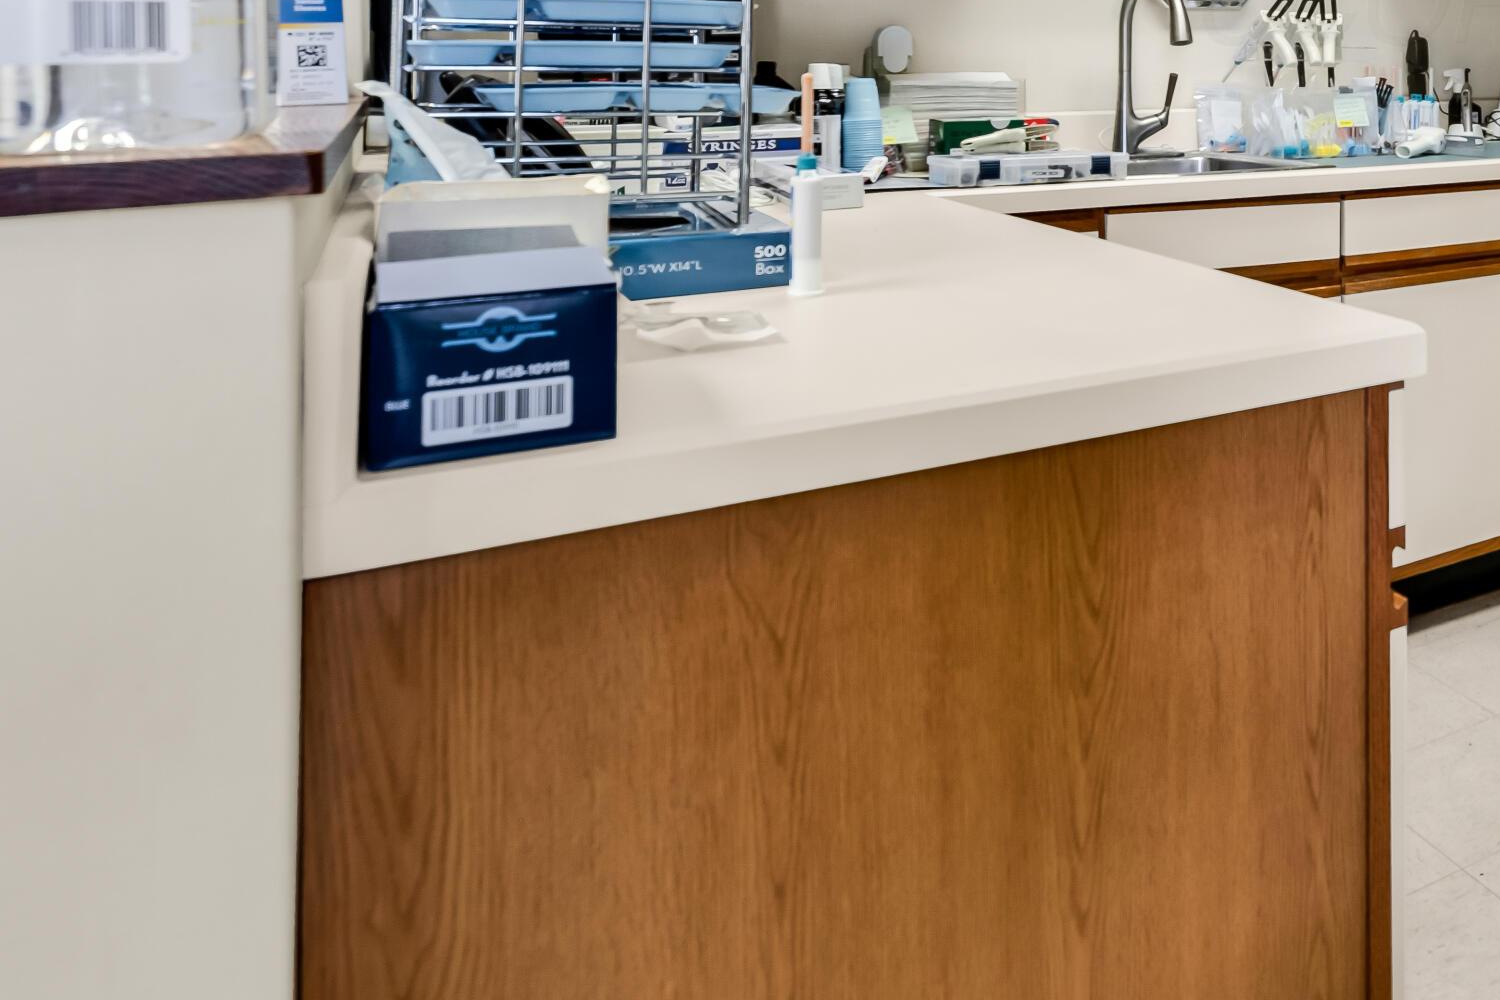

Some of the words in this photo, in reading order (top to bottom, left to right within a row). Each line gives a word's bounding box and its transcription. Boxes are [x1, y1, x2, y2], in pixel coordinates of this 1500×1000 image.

[753, 244, 787, 259] 500
[755, 262, 784, 276] Box
[426, 370, 481, 388] Reorder
